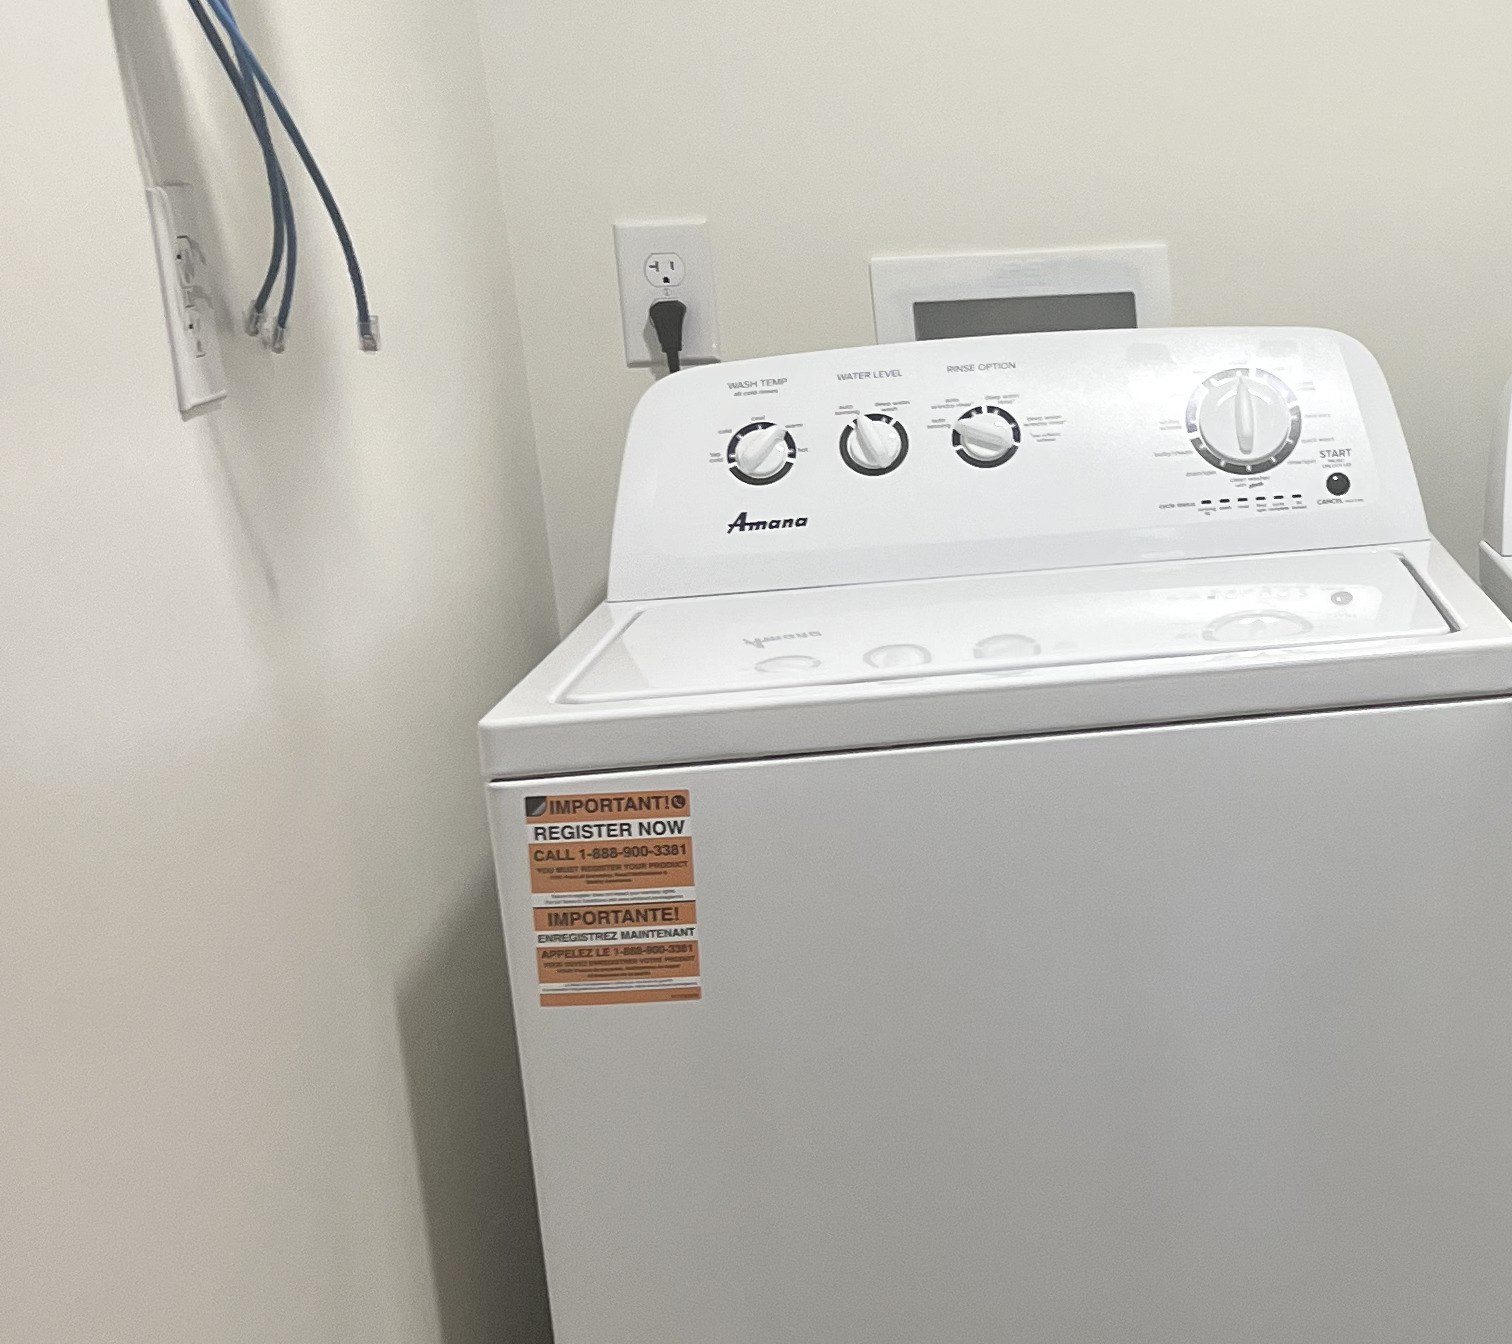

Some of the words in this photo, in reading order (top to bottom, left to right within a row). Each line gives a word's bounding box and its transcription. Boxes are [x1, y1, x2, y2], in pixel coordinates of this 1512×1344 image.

[946, 365, 975, 373] RINSE
[977, 361, 1016, 372] OPTION
[836, 371, 871, 381] WATER
[873, 369, 903, 379] LEVEL
[727, 380, 758, 390] WASH
[760, 377, 788, 387] TEMP
[1319, 448, 1352, 460] START
[1316, 498, 1344, 506] CANCEL
[727, 511, 809, 534] Amana
[550, 795, 670, 815] IMPORTANT!
[533, 823, 632, 841] REGISTER
[638, 819, 686, 837] NOW
[533, 849, 576, 862] CALL
[547, 906, 680, 926] IMPORTANTE!
[537, 931, 618, 944] ENREGISTREZ
[620, 927, 696, 940] MAINTENANT
[541, 947, 594, 959] APPELEZ
